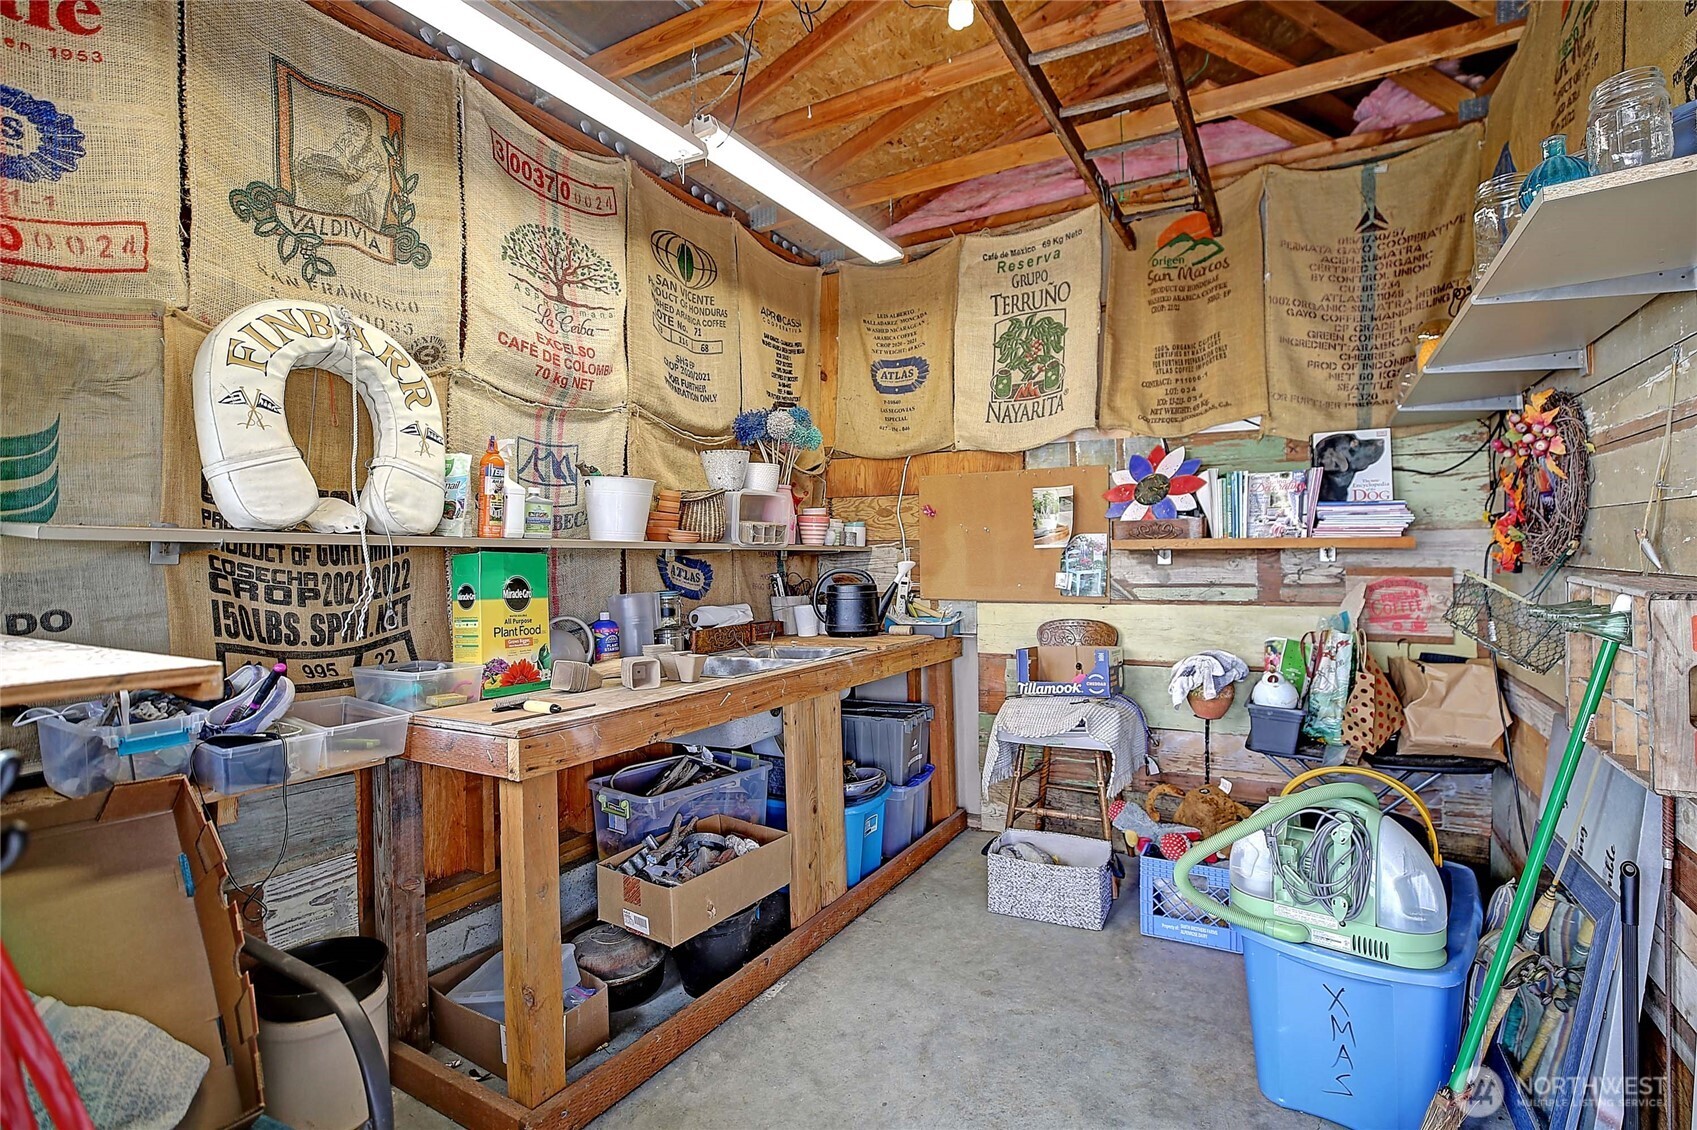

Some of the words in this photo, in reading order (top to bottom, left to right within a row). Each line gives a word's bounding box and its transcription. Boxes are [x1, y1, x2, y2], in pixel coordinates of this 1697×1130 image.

[48, 47, 103, 63] 1953
[495, 139, 505, 162] 3
[510, 153, 556, 193] 0037
[288, 210, 382, 254] VALDIVIA
[1041, 240, 1052, 249] 69
[1052, 236, 1064, 245] Kg
[1065, 228, 1083, 241] Neto
[1280, 240, 1332, 254] PERMATA
[1337, 244, 1372, 255] GAYO
[1377, 213, 1466, 251] COOPERATIVE
[997, 249, 1061, 273] Reserva
[1151, 256, 1185, 268] origen
[1309, 263, 1368, 274] CERTIFIED
[1374, 250, 1434, 272] ORGANIC
[1011, 269, 1048, 289] GRUPO
[1147, 269, 1174, 287] San
[1177, 257, 1230, 282] Marcos
[1311, 273, 1325, 282] BY
[1394, 261, 1432, 278] UNION
[309, 279, 419, 314] FRANCISCO
[655, 273, 677, 293] SAN
[679, 285, 716, 306] VICENTE
[990, 281, 1071, 317] TERRUÑO
[688, 304, 728, 318] HONDURAS
[1292, 298, 1346, 312] ORGANIC
[1351, 298, 1412, 313] SUMATRA
[555, 310, 596, 338] Ceiba
[702, 319, 727, 328] COFFEE
[1286, 307, 1317, 319] GAYO
[1321, 313, 1367, 324] COFFEE
[1306, 330, 1345, 342] GREEN
[1348, 329, 1395, 342] COFFEE
[1353, 320, 1396, 333] GRADE
[497, 331, 539, 358] CAFÉ
[542, 349, 561, 368] DE
[535, 331, 596, 359] EXCELSO
[700, 344, 709, 352] 68
[1171, 342, 1197, 351] ORGANIC
[1198, 331, 1221, 347] COFFEE
[1154, 349, 1182, 359] CERTIFIED
[1339, 350, 1395, 361] CHERRIES
[880, 369, 914, 380] ATLAS
[1155, 366, 1173, 375] ATLAS
[1174, 364, 1194, 374] COFFEE
[1307, 360, 1338, 371] PROD
[1341, 361, 1358, 371] OF
[535, 364, 551, 380] 70
[552, 372, 569, 389] kg
[571, 376, 595, 391] NET
[1328, 372, 1355, 381] NET
[1359, 373, 1374, 381] 60
[1337, 380, 1393, 392] SEATTLE
[985, 395, 1064, 424] NAYARITA
[1353, 489, 1390, 500] DOG
[552, 511, 588, 531] BEC
[208, 554, 319, 588] COSECHA
[670, 564, 700, 583] ATLAS
[209, 571, 321, 607] CROP
[502, 588, 533, 599] Miracle-Gro
[493, 625, 518, 638] Plant
[519, 624, 541, 636] Food
[504, 617, 512, 625] All
[512, 617, 532, 626] Purpose
[374, 649, 398, 666] 22
[302, 662, 339, 679] 995
[1018, 682, 1082, 695] Tillamook
[1321, 983, 1357, 1097] XMAS
